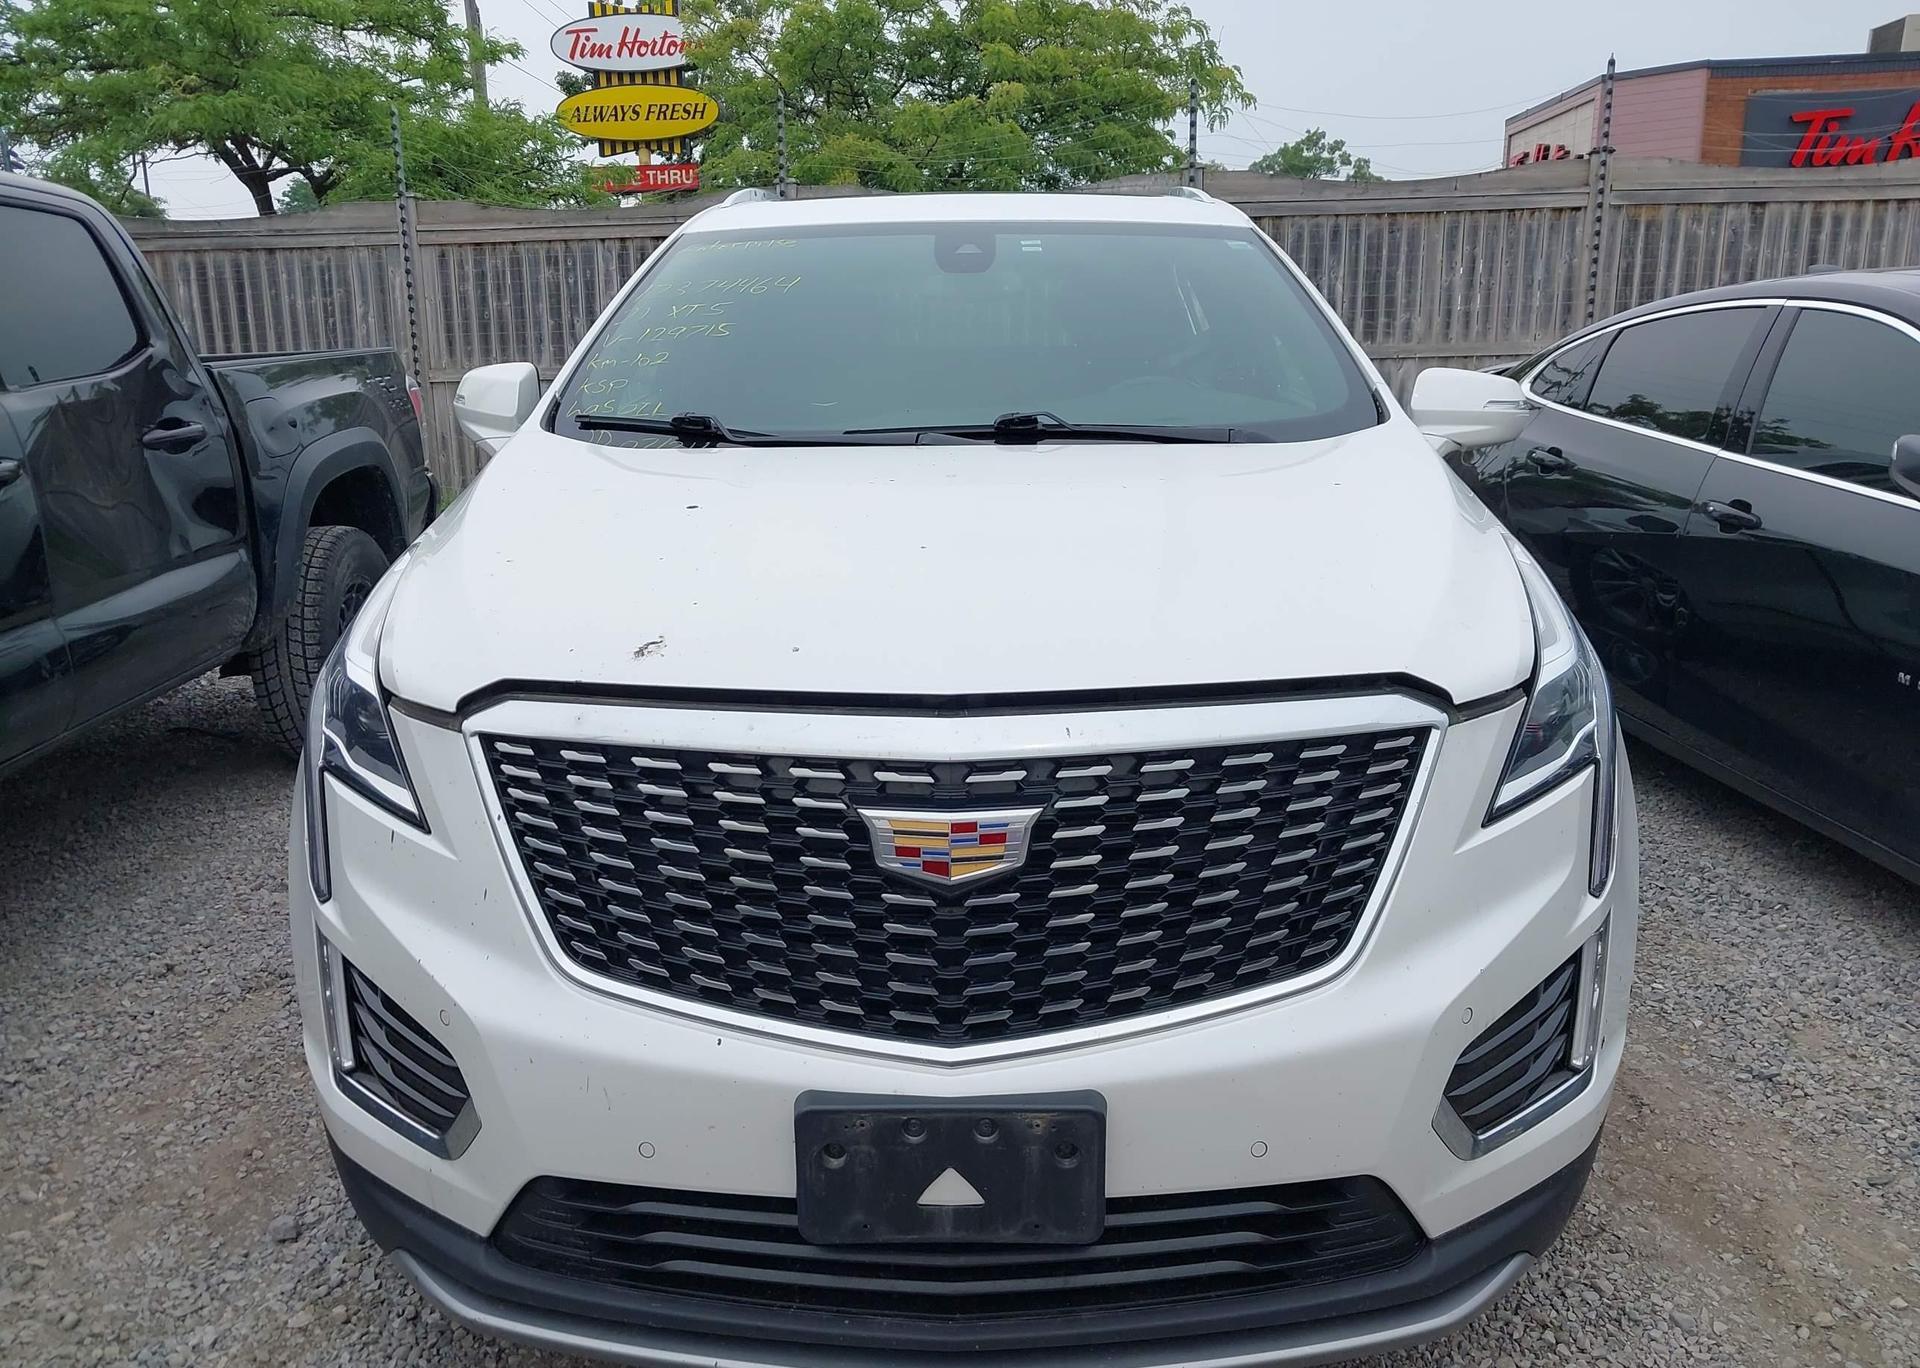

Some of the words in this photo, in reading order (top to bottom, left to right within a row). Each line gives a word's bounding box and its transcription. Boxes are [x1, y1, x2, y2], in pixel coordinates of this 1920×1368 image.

[565, 27, 611, 60] Tim
[570, 104, 641, 123] ALWAYS
[644, 103, 707, 122] FRESH
[1791, 107, 1880, 168] Tim
[646, 169, 693, 185] THRU
